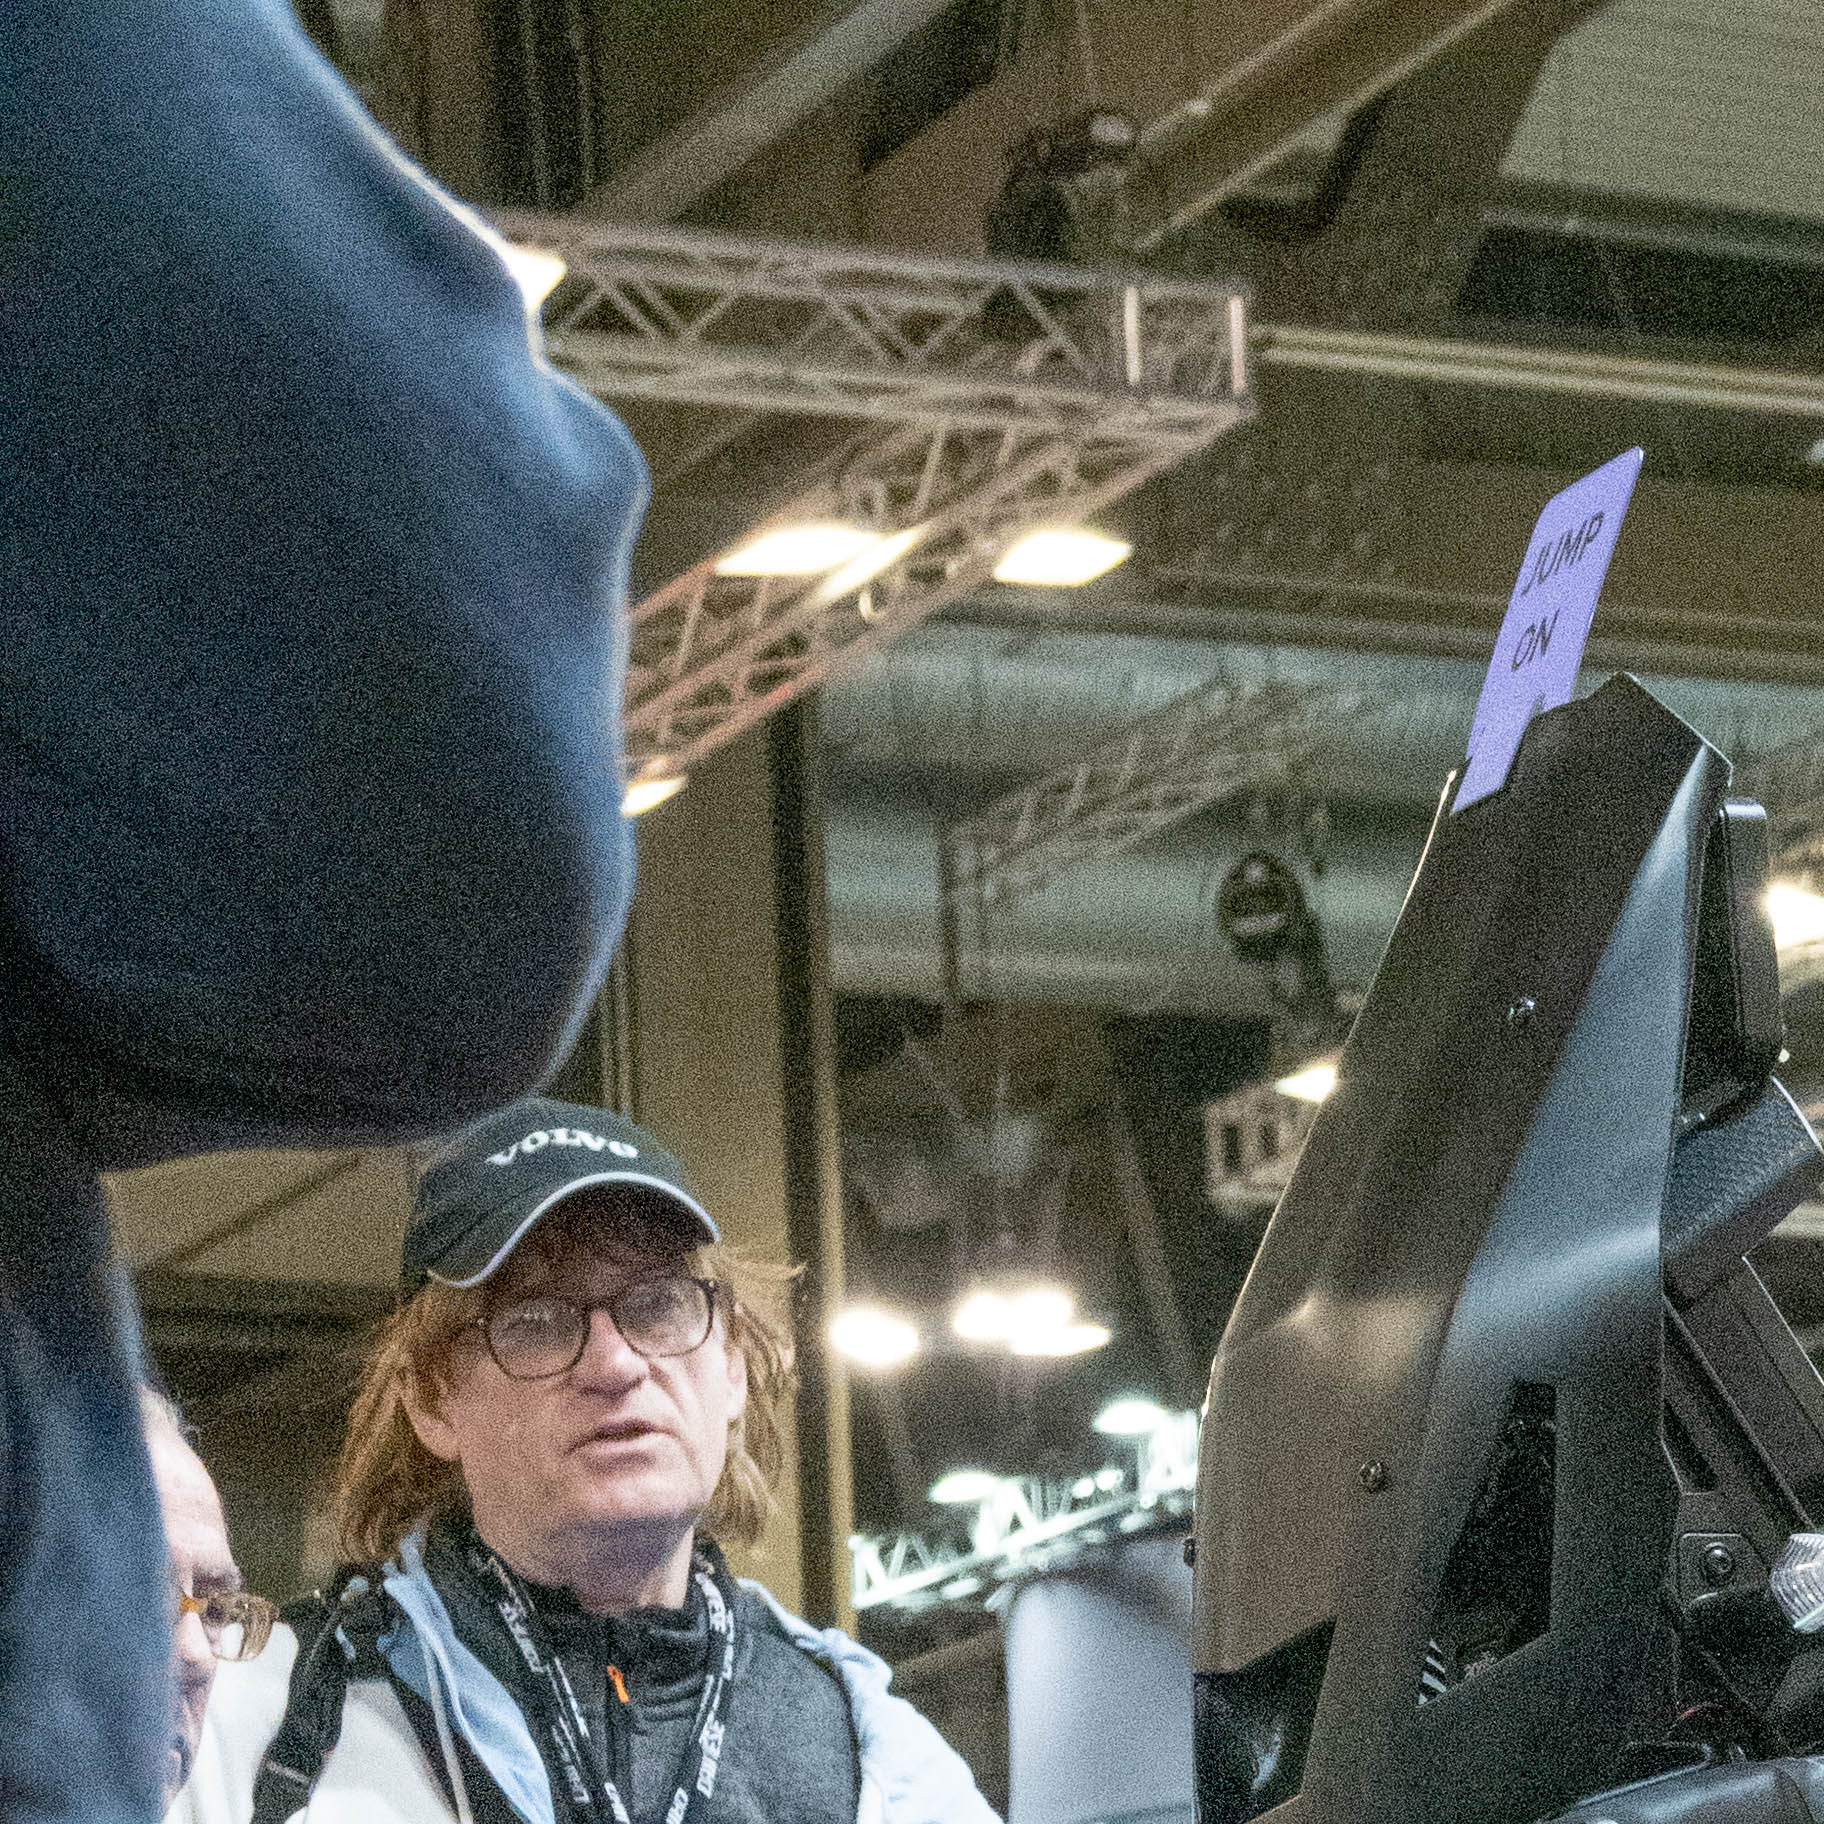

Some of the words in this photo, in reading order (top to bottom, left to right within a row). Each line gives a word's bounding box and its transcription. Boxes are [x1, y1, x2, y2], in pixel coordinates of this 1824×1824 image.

[1521, 510, 1604, 597] JUMP
[1511, 608, 1561, 672] ON
[484, 1127, 639, 1166] VOLVO
